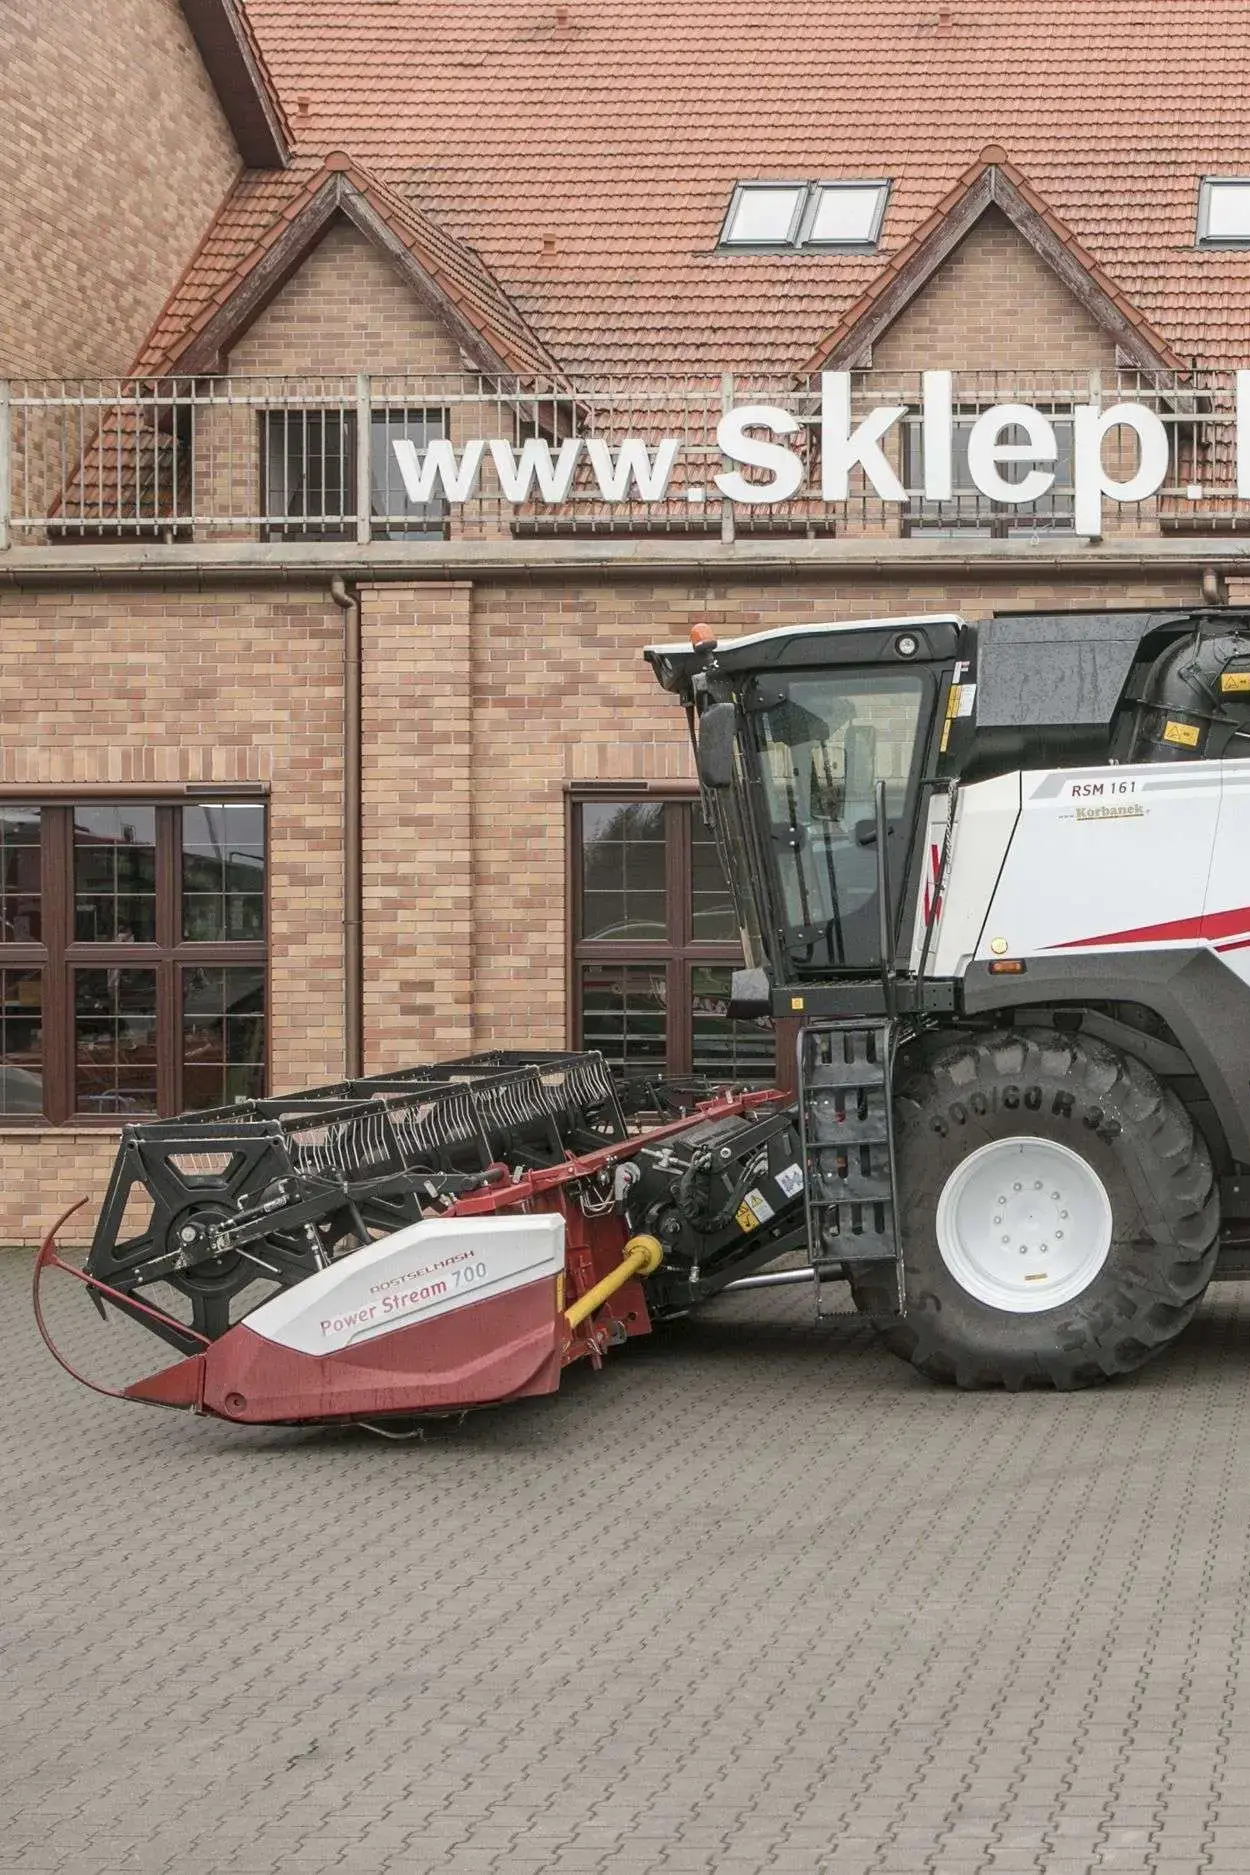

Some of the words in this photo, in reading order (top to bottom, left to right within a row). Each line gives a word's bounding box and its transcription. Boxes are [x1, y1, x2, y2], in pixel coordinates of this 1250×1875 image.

[1071, 784, 1104, 797] RSM
[1111, 781, 1136, 794] 161
[369, 1250, 475, 1294] ROSTSELMASH
[320, 1306, 376, 1337] Power
[382, 1280, 447, 1314] Stream
[451, 1262, 487, 1289] 700
